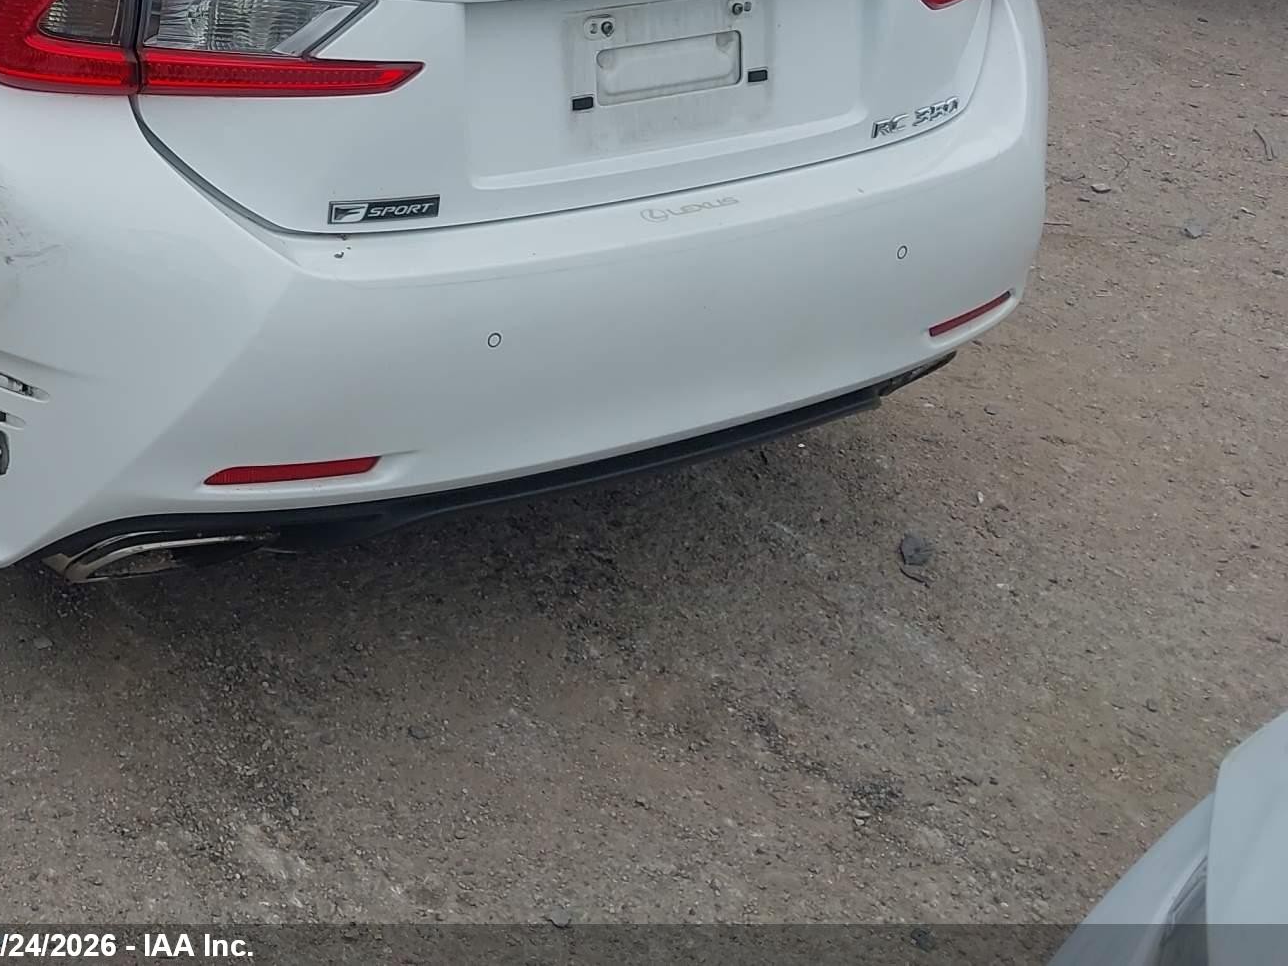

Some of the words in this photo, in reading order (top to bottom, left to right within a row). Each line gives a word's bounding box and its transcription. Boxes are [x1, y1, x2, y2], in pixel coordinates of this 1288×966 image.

[871, 114, 909, 138] RC
[912, 96, 959, 126] 350
[368, 203, 434, 217] SPORT
[667, 197, 740, 216] LEXUS
